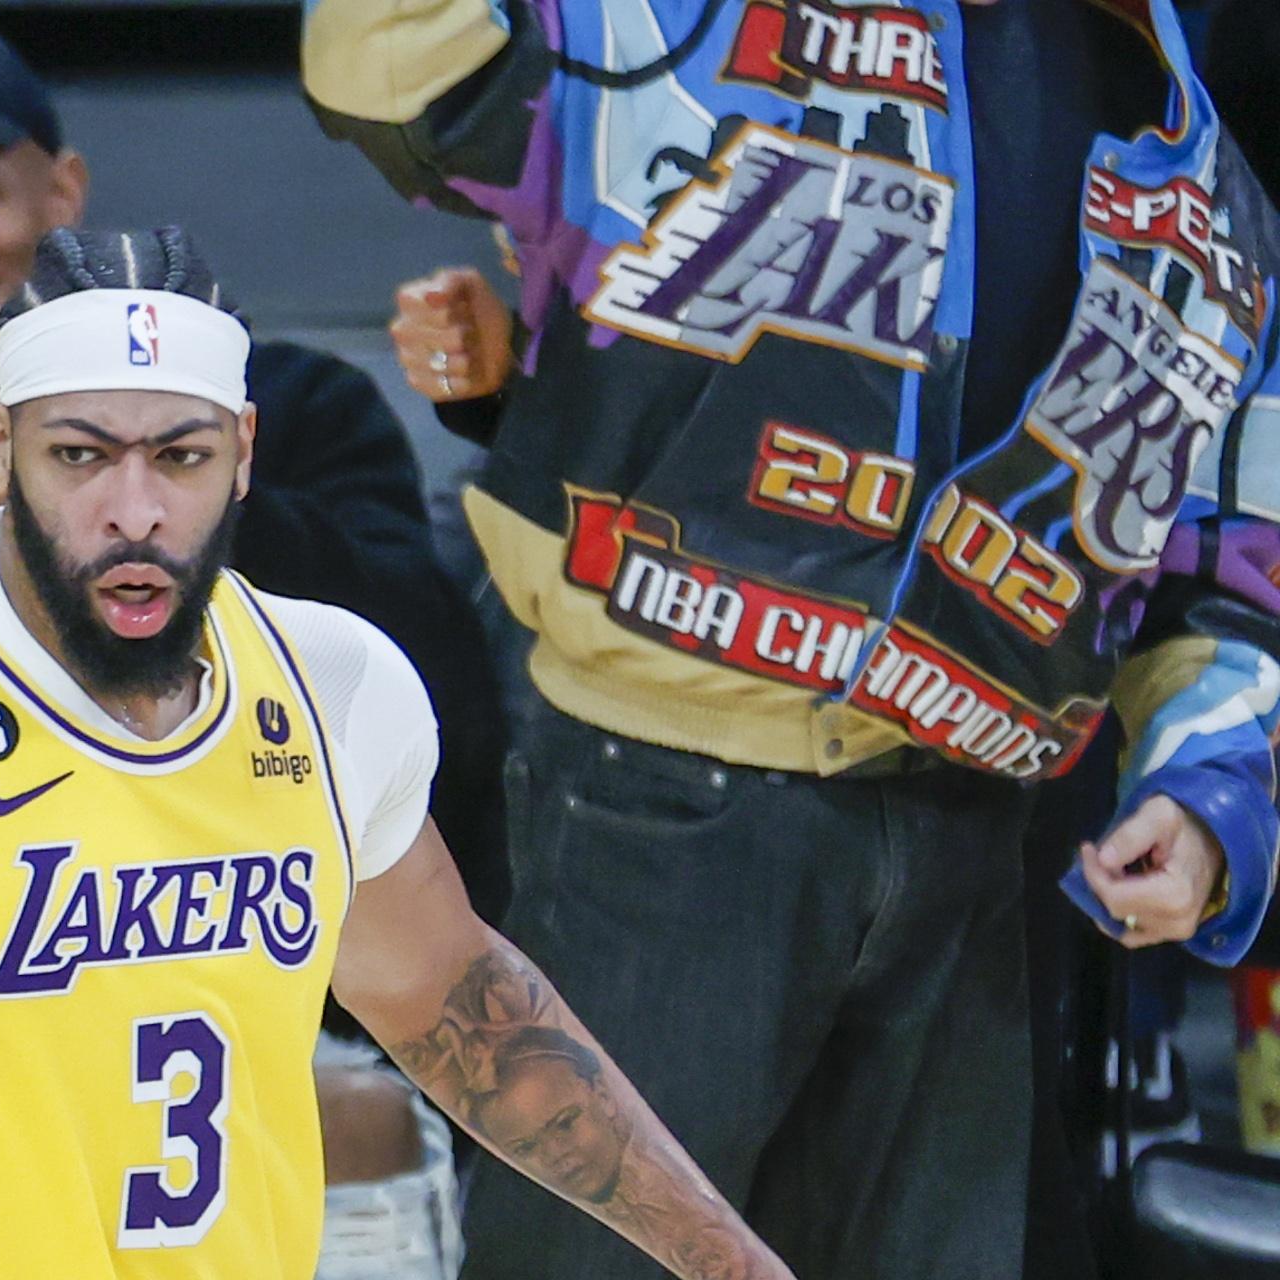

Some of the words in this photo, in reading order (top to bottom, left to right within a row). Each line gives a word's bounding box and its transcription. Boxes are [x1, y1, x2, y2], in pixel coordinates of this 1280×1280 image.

[845, 175, 941, 225] LOS
[616, 553, 744, 650] NBA
[252, 750, 313, 784] bibigo
[116, 1010, 230, 1249] 3
